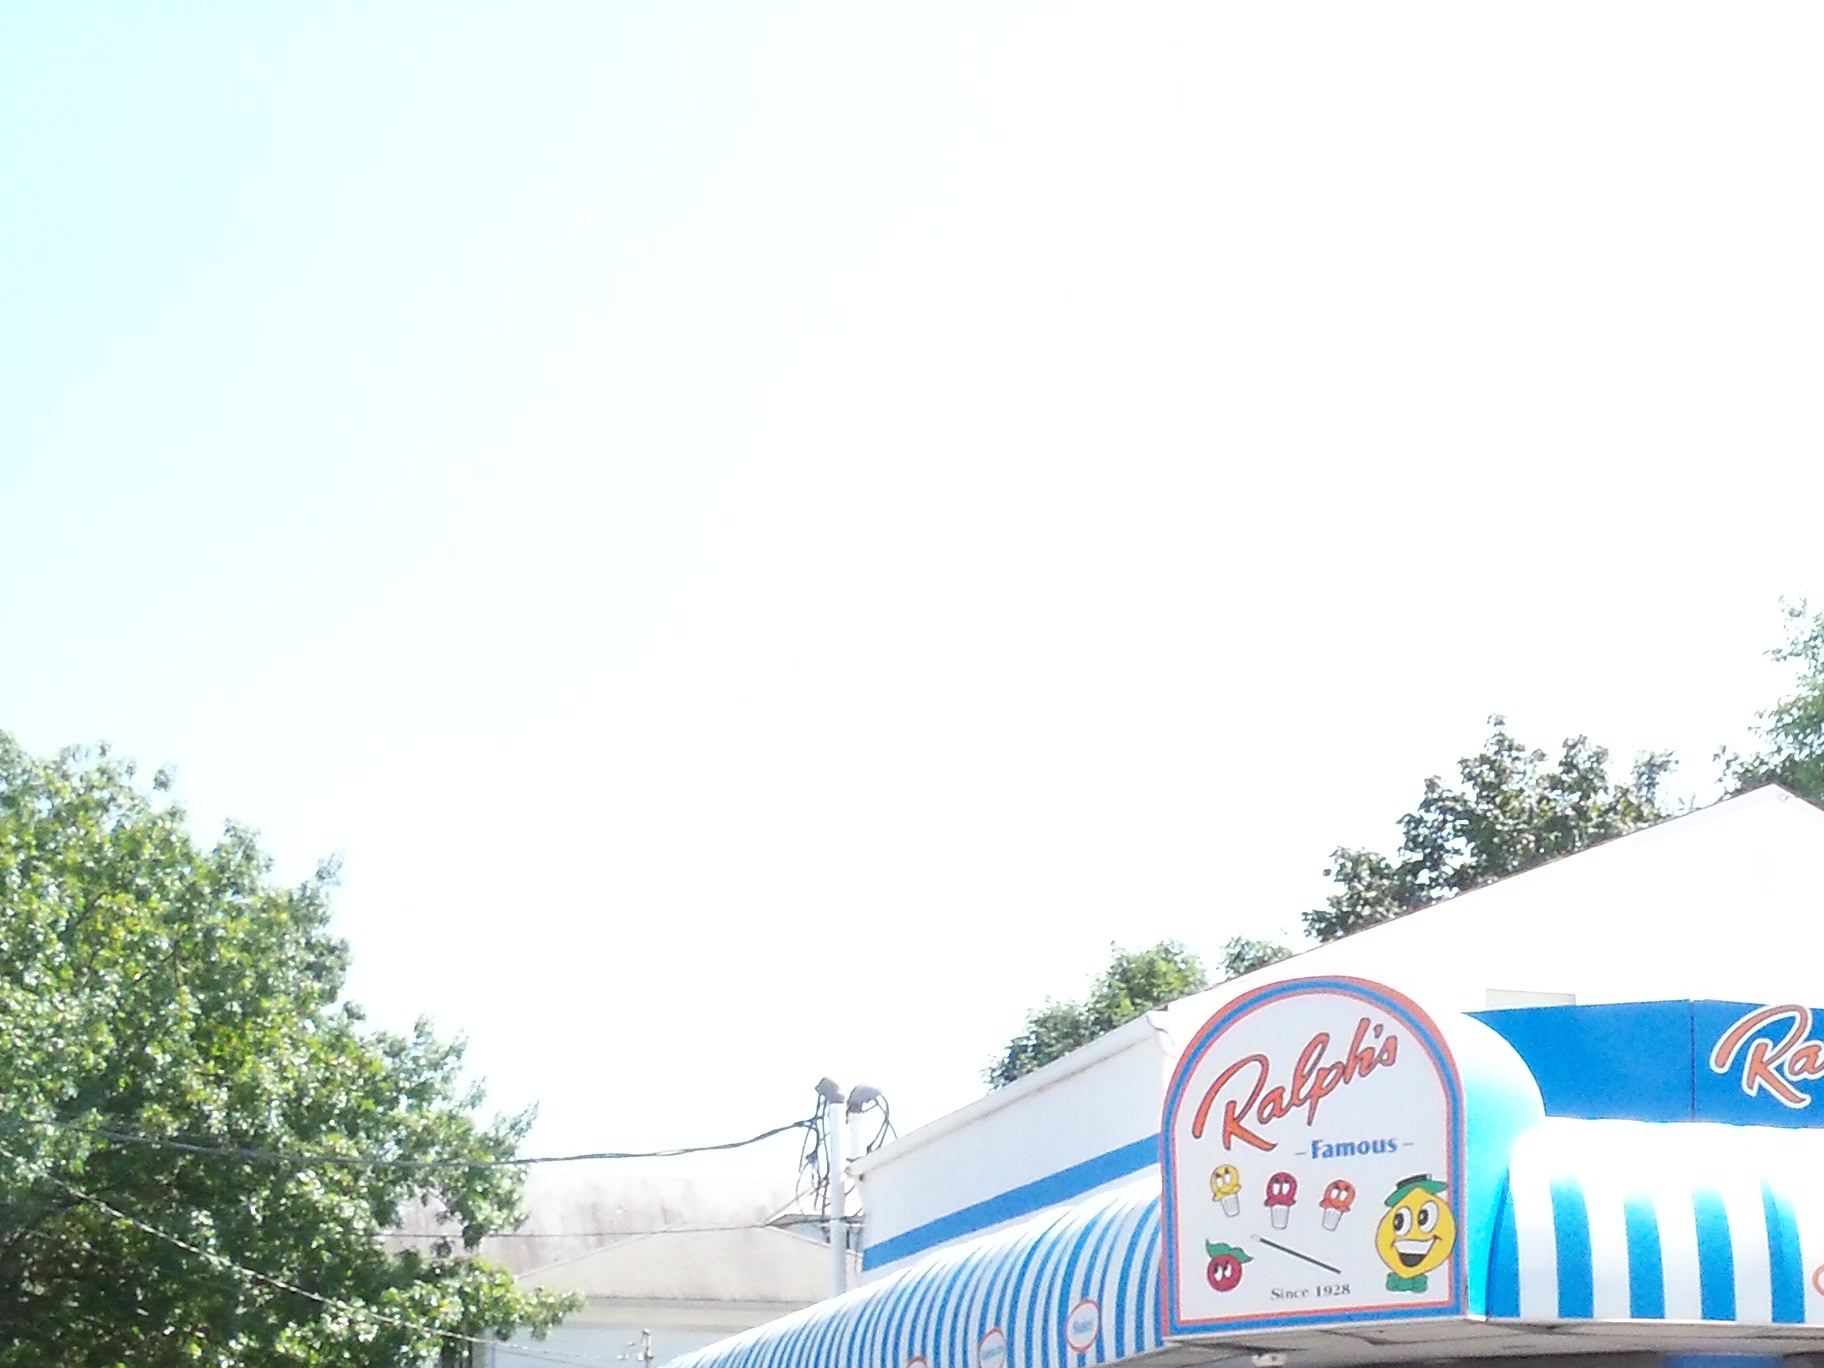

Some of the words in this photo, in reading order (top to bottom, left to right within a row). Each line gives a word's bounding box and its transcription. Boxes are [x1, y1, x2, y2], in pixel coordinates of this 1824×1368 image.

[1191, 1017, 1398, 1150] Ralph's
[1310, 1138, 1399, 1160] Famous
[1270, 1287, 1309, 1300] Since
[1314, 1284, 1351, 1298] 1928
